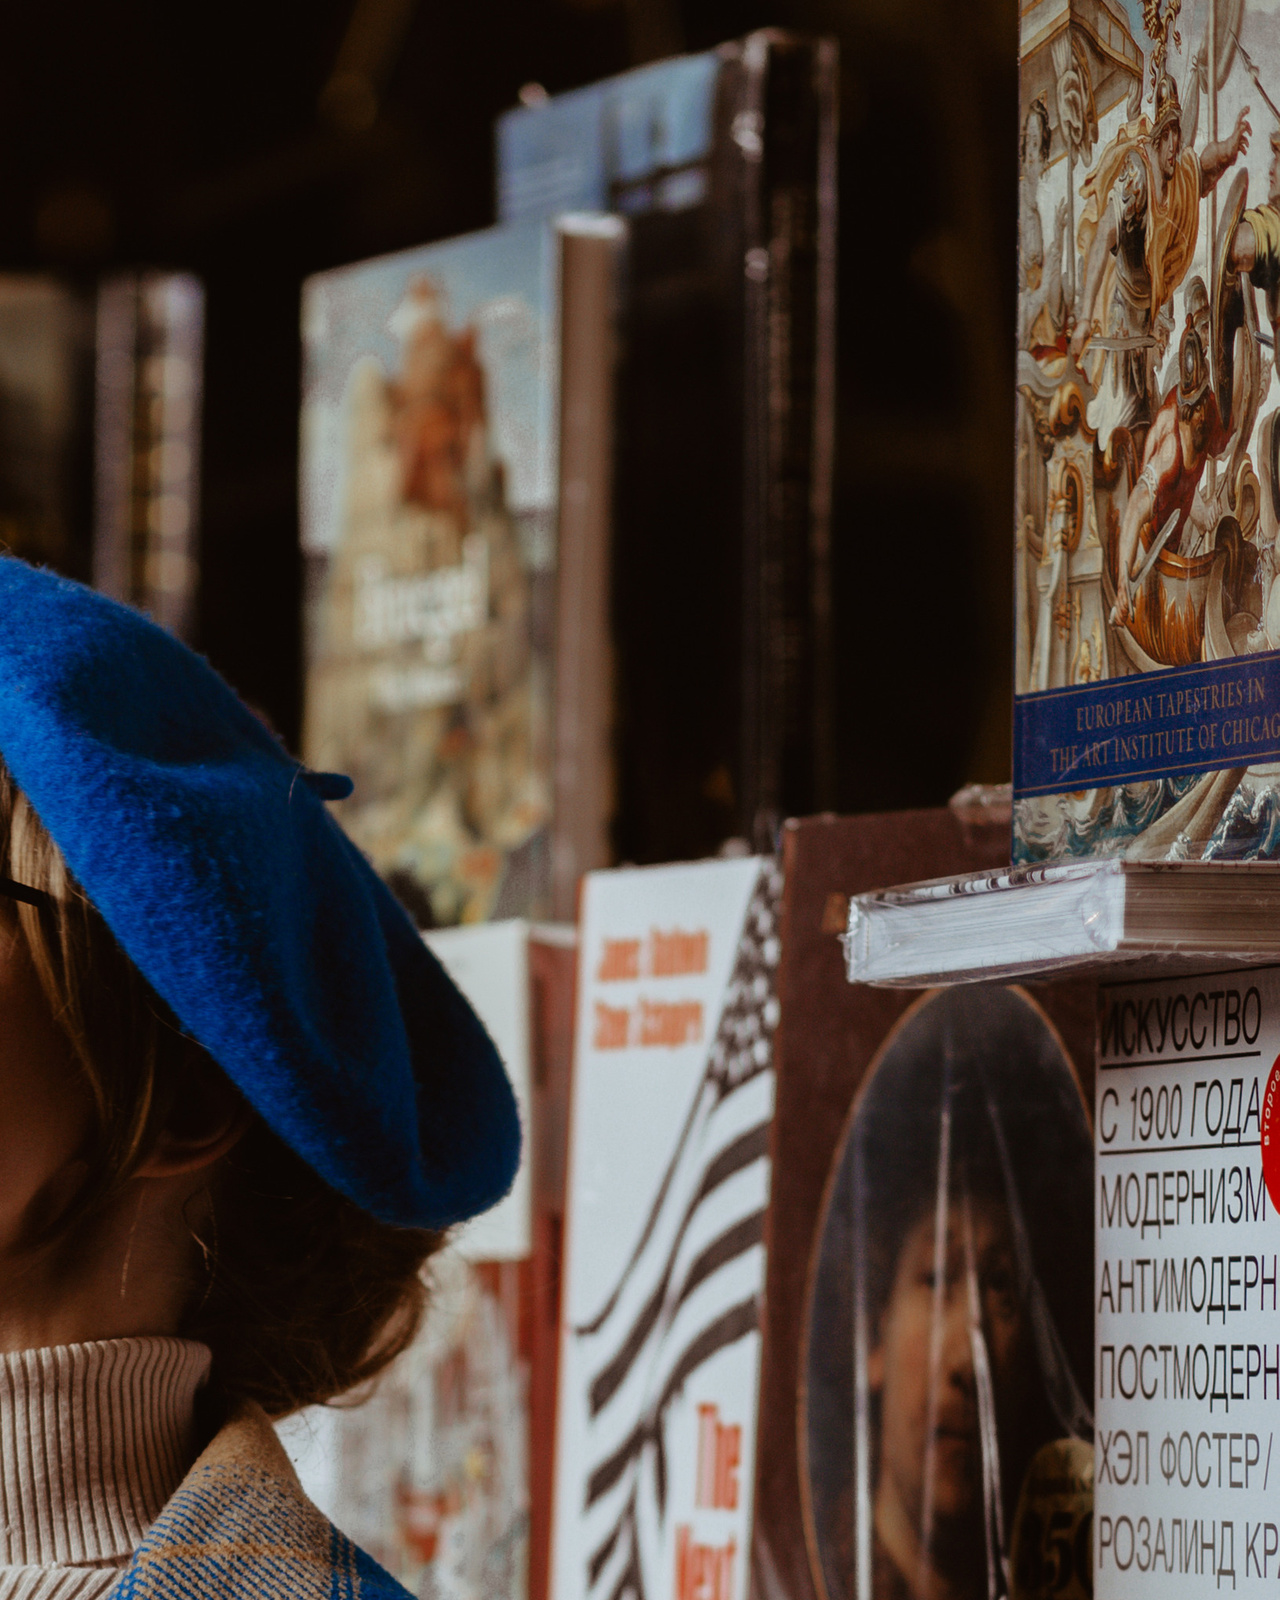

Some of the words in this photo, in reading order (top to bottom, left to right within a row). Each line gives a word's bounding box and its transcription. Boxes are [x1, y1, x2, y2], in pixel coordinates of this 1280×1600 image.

[1076, 697, 1153, 731] EUROPEAN
[1157, 680, 1243, 718] TAPESTRIES
[1248, 676, 1265, 704] IN
[1050, 746, 1078, 773] THE
[1083, 739, 1110, 768] ART
[1114, 727, 1194, 763] INSTITUTE
[1199, 723, 1217, 750] OF
[1100, 986, 1261, 1058] ИСКУССТВО
[1100, 1088, 1119, 1144] С
[1131, 1084, 1182, 1142] 1900
[1191, 1077, 1261, 1147] ГОДА
[1101, 1166, 1266, 1239] МОДЕРНИЗМ
[1098, 1255, 1277, 1325] АНТИМОДЕРН
[1100, 1343, 1280, 1413] ПОСТМОДЕРН
[1098, 1430, 1149, 1485] ХЭЛ
[1099, 1515, 1236, 1590] РОЗАЛИНД
[1245, 1521, 1280, 1580] КР
